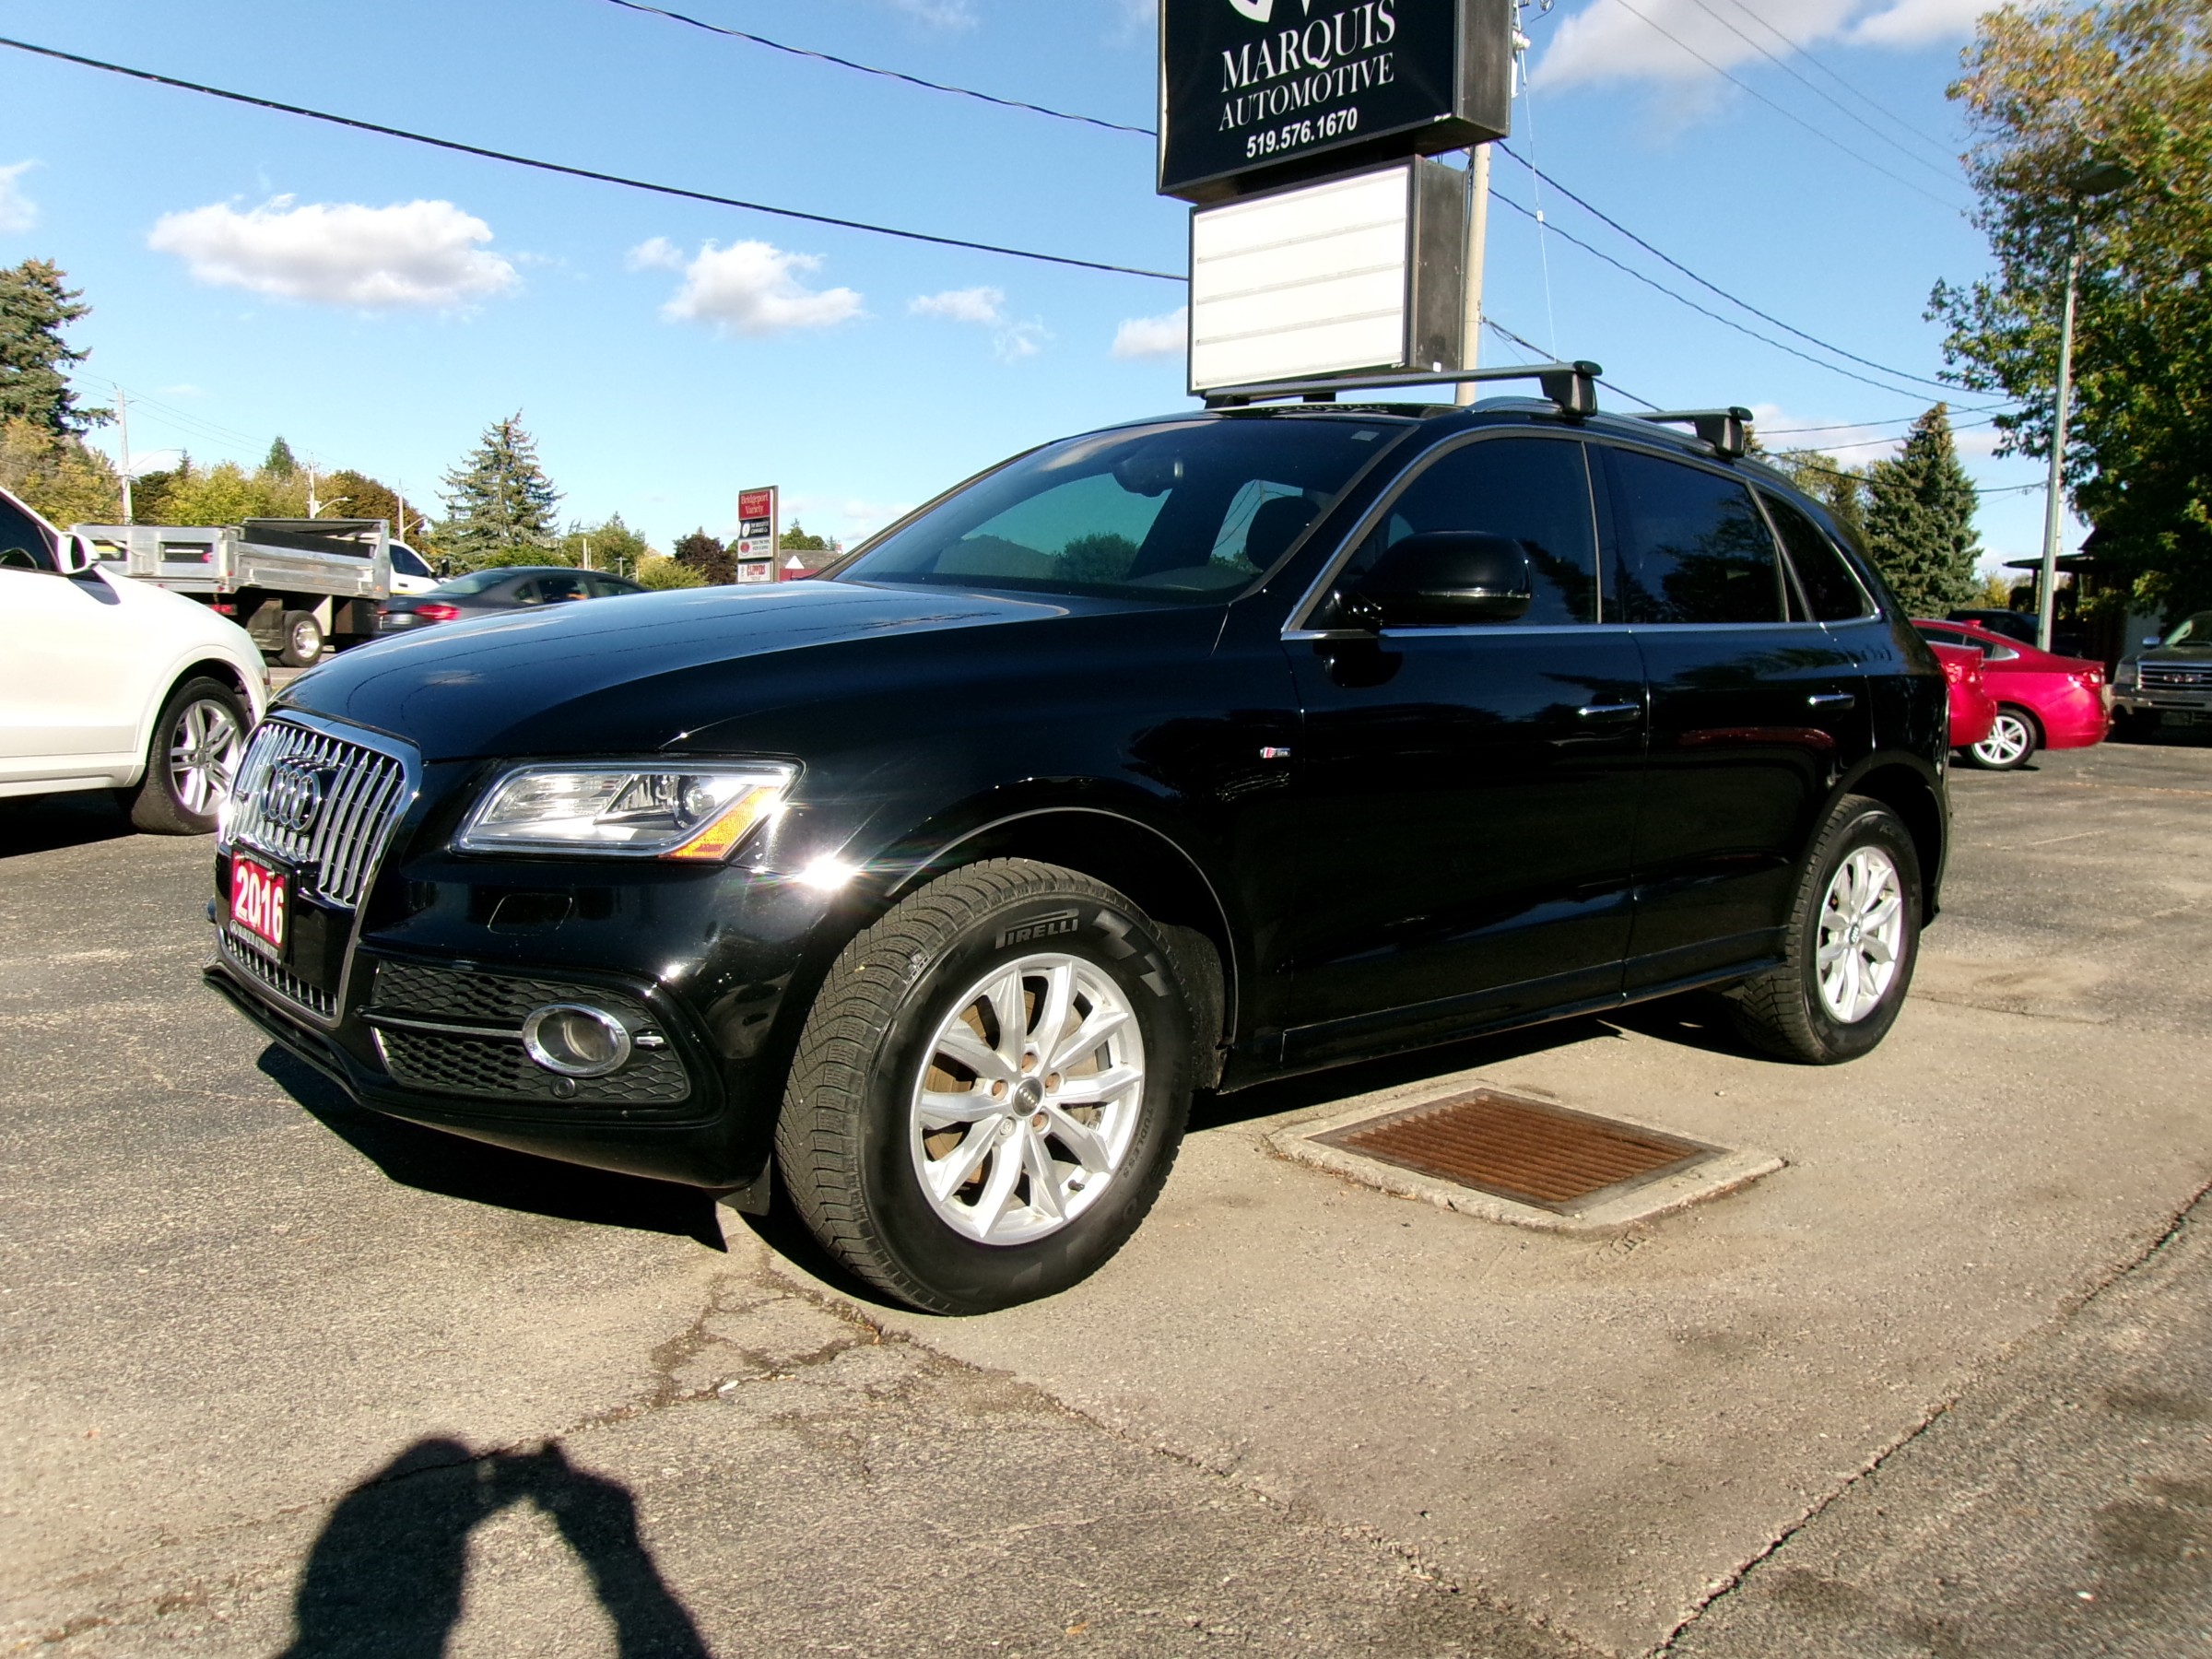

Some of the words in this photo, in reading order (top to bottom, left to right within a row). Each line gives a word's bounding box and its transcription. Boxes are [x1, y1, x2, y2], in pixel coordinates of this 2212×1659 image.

[1221, 0, 1395, 92] MARQUIS
[1218, 52, 1394, 131] AUTOMOTIVE
[1246, 107, 1358, 159] 519.576.1670
[741, 493, 768, 506] Bridgeport
[745, 505, 764, 515] Variety
[235, 865, 285, 945] 2016
[994, 909, 1079, 949] PIRELLI
